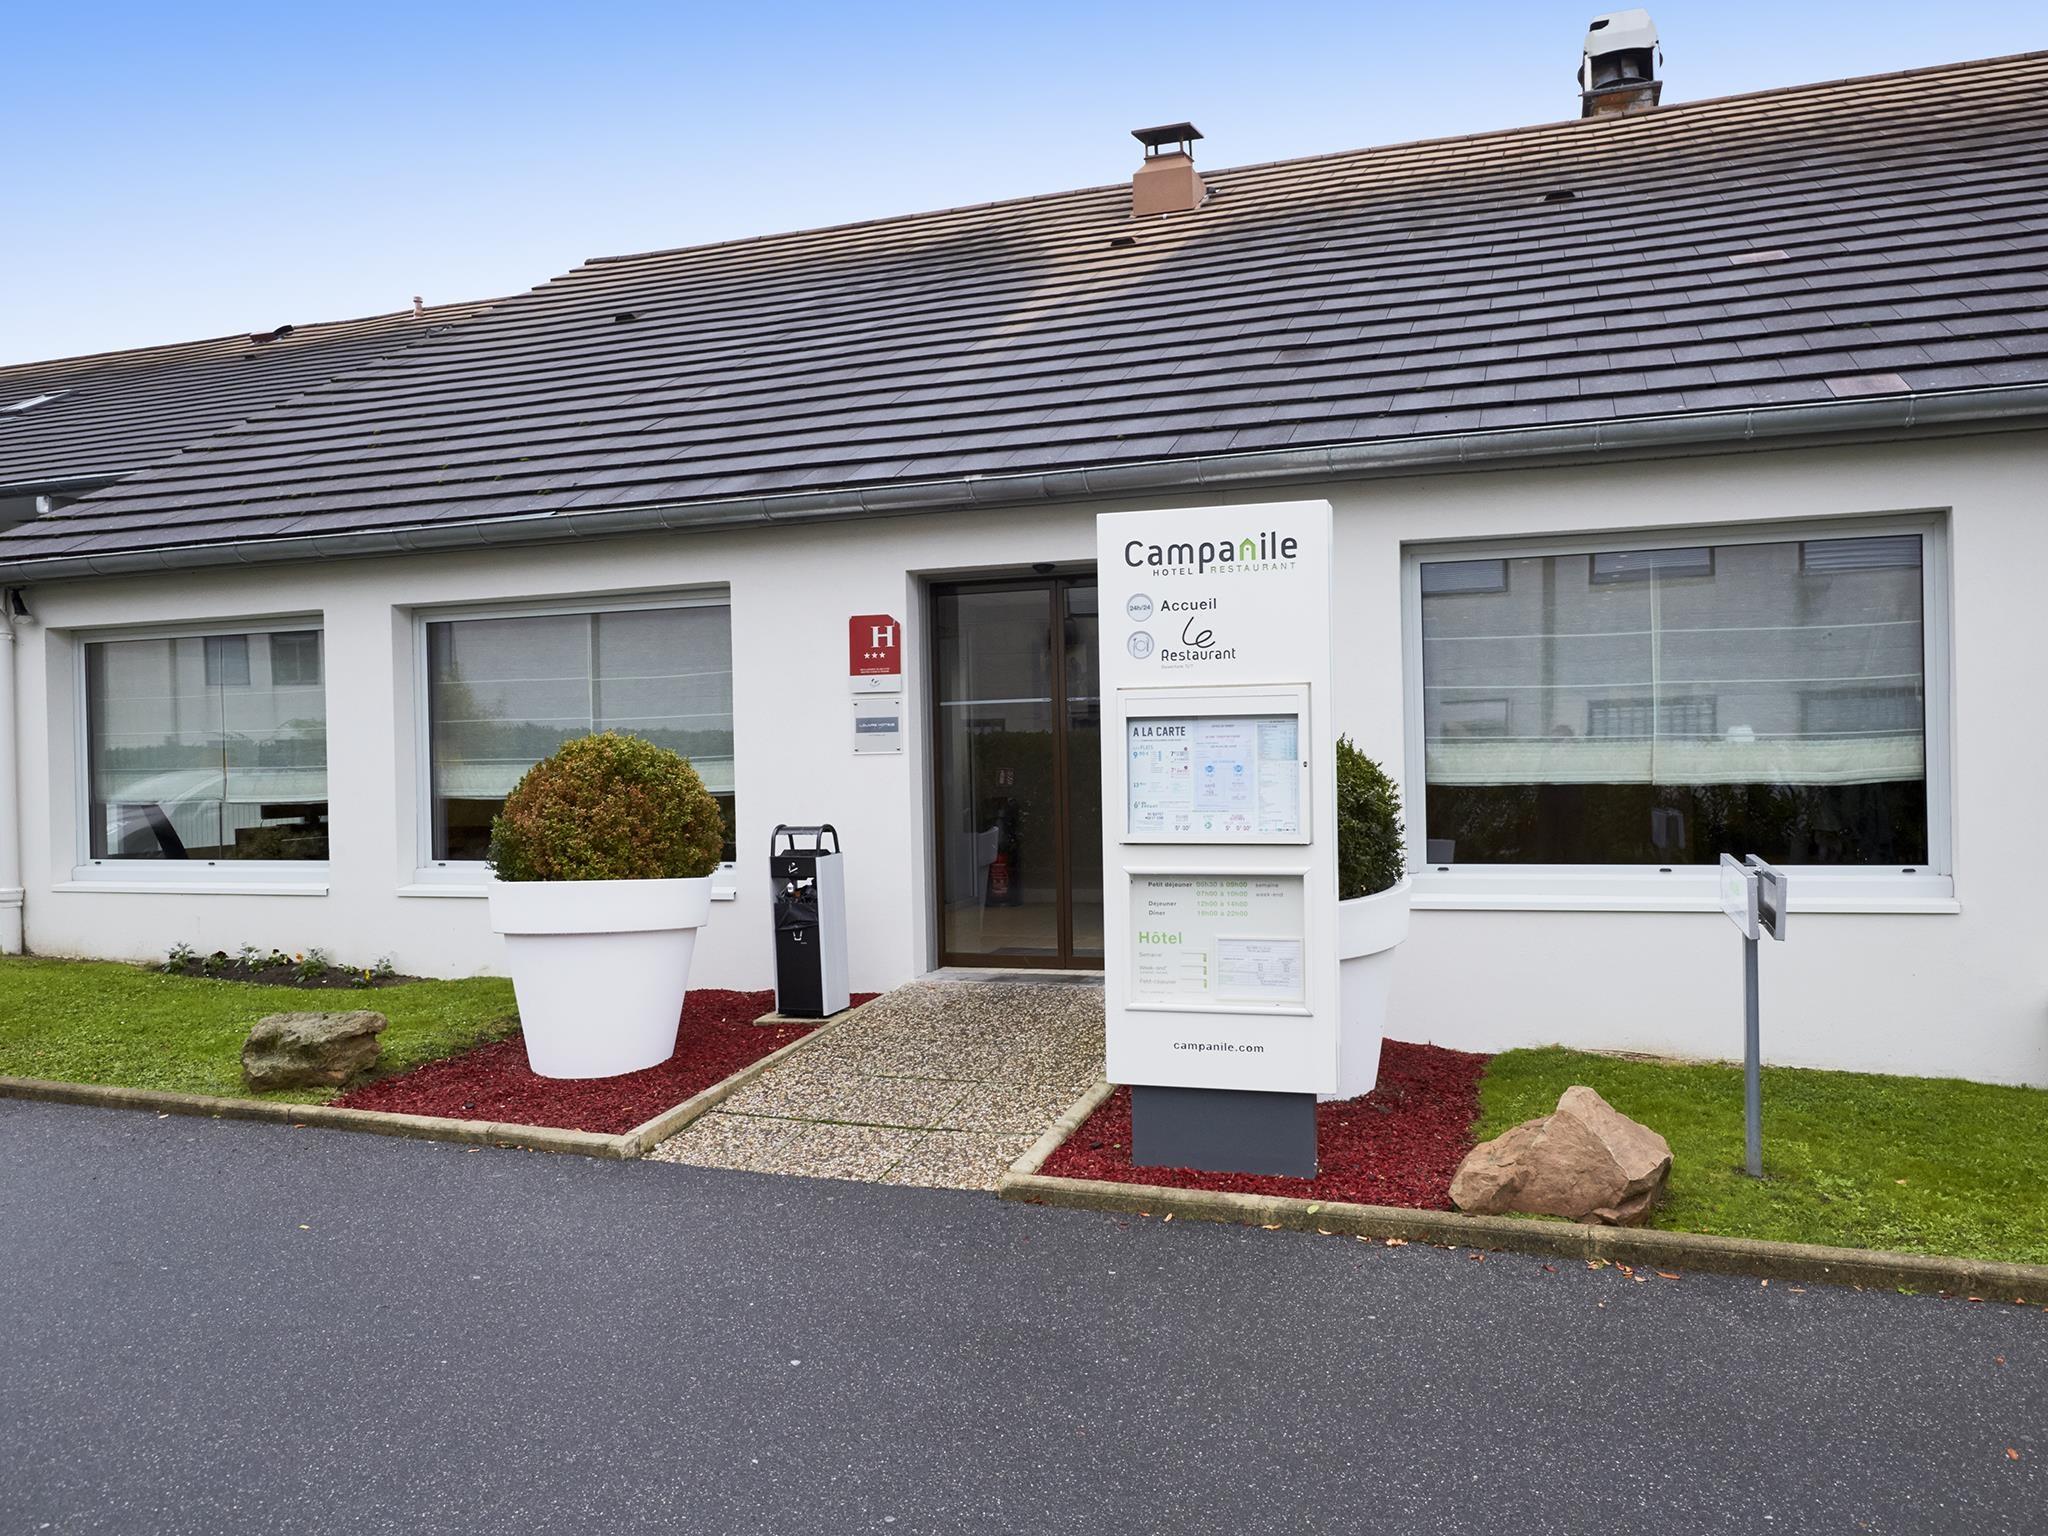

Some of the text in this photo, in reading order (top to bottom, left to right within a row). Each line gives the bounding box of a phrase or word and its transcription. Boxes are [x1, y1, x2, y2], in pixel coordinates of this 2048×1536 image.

[1125, 531, 1298, 574] Campanile
[1153, 562, 1297, 577] HOTEL RESTAURANT
[1161, 598, 1217, 612] Accueil
[870, 625, 895, 649] H
[1161, 648, 1237, 662] Restaurant
[1133, 726, 1186, 737] A LA CARTE
[1138, 931, 1182, 945] Hôtel
[1173, 1041, 1264, 1053] campanile.com
